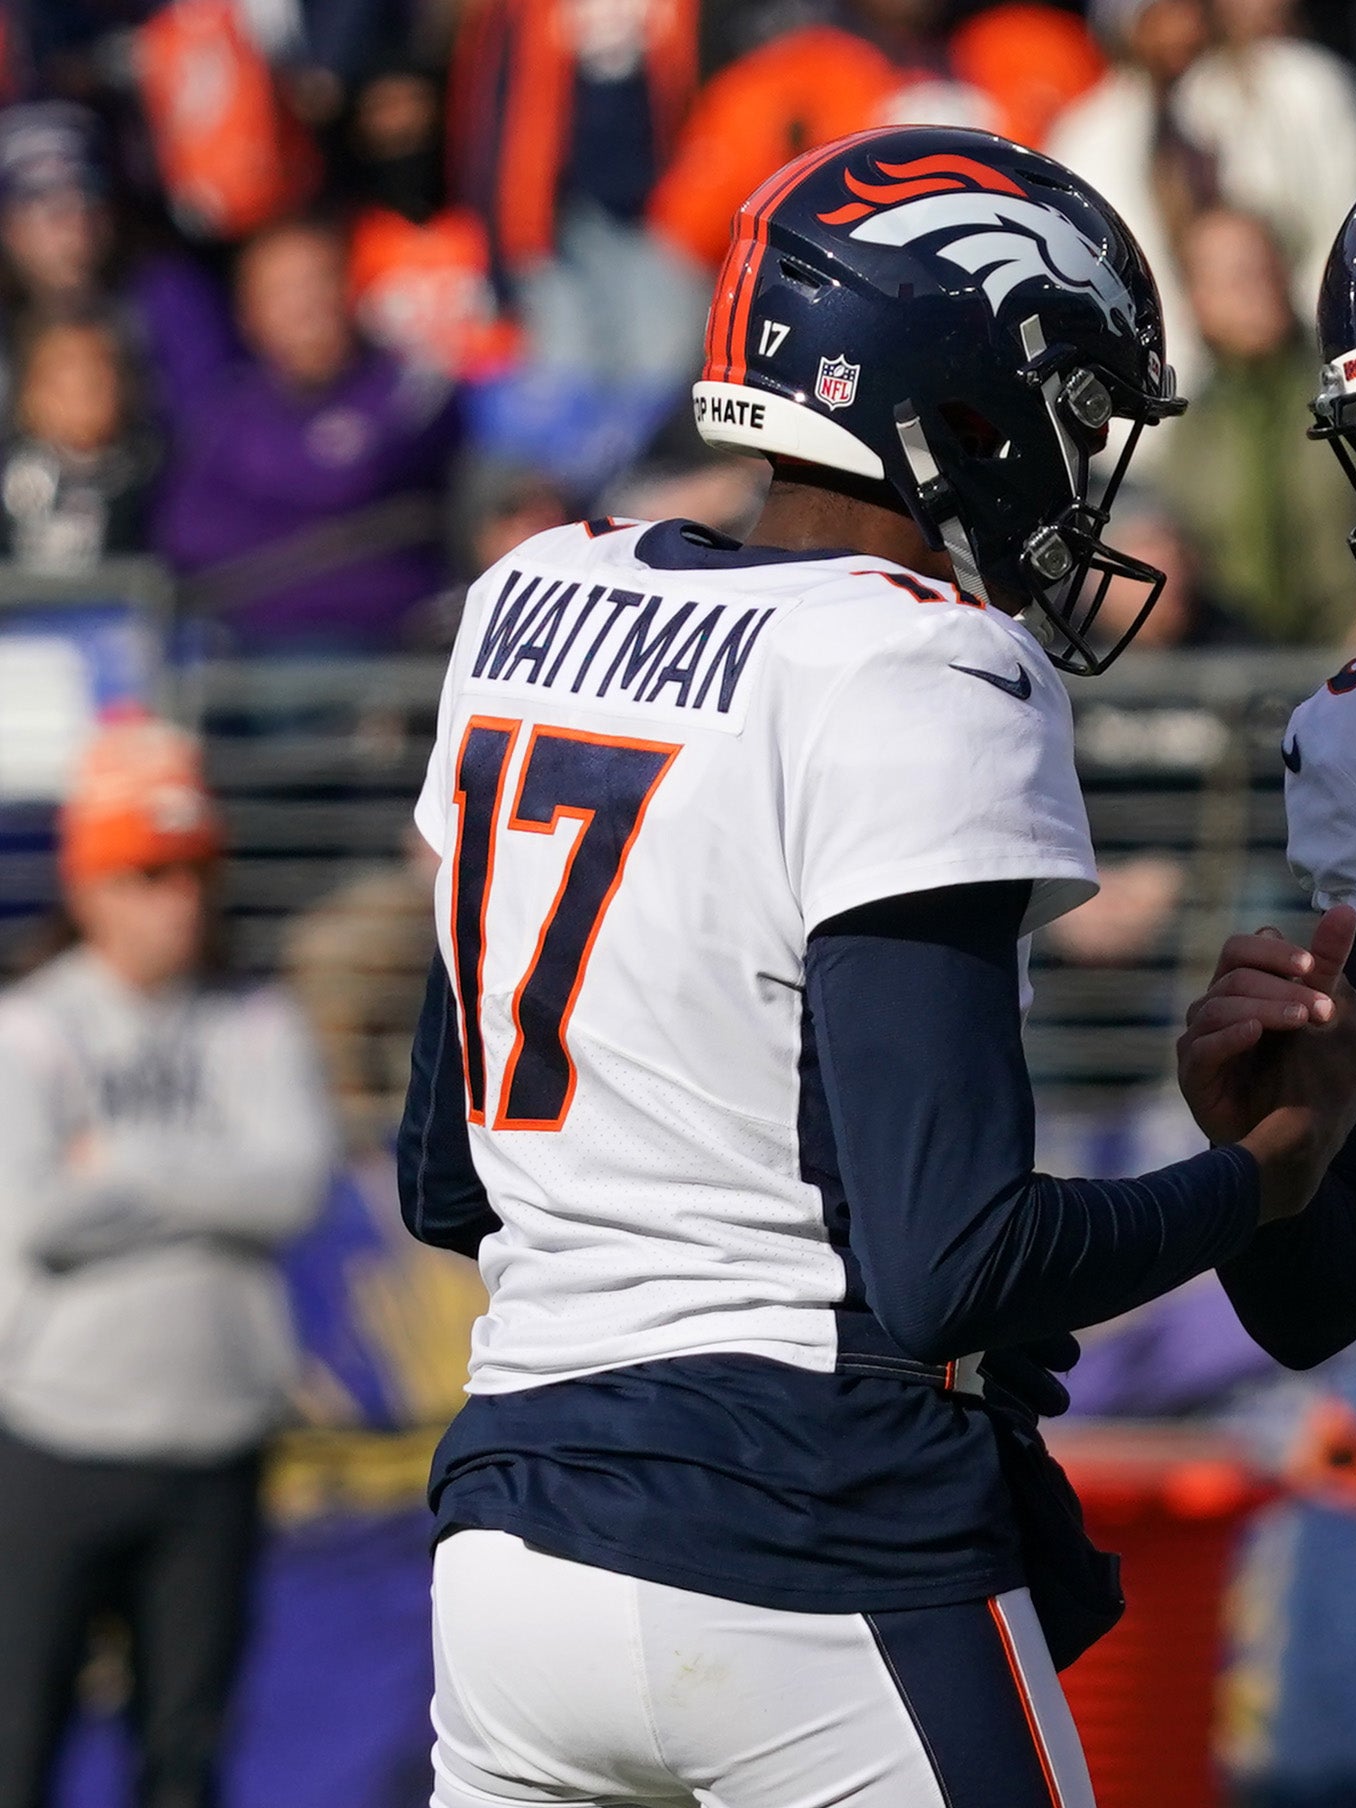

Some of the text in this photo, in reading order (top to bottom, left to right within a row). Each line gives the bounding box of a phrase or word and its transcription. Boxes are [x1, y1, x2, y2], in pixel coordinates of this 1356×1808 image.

[758, 319, 791, 357] 17
[821, 377, 849, 401] NFL
[711, 397, 766, 429] HATE
[470, 570, 776, 713] WAITMAN
[453, 715, 684, 1131] 17
